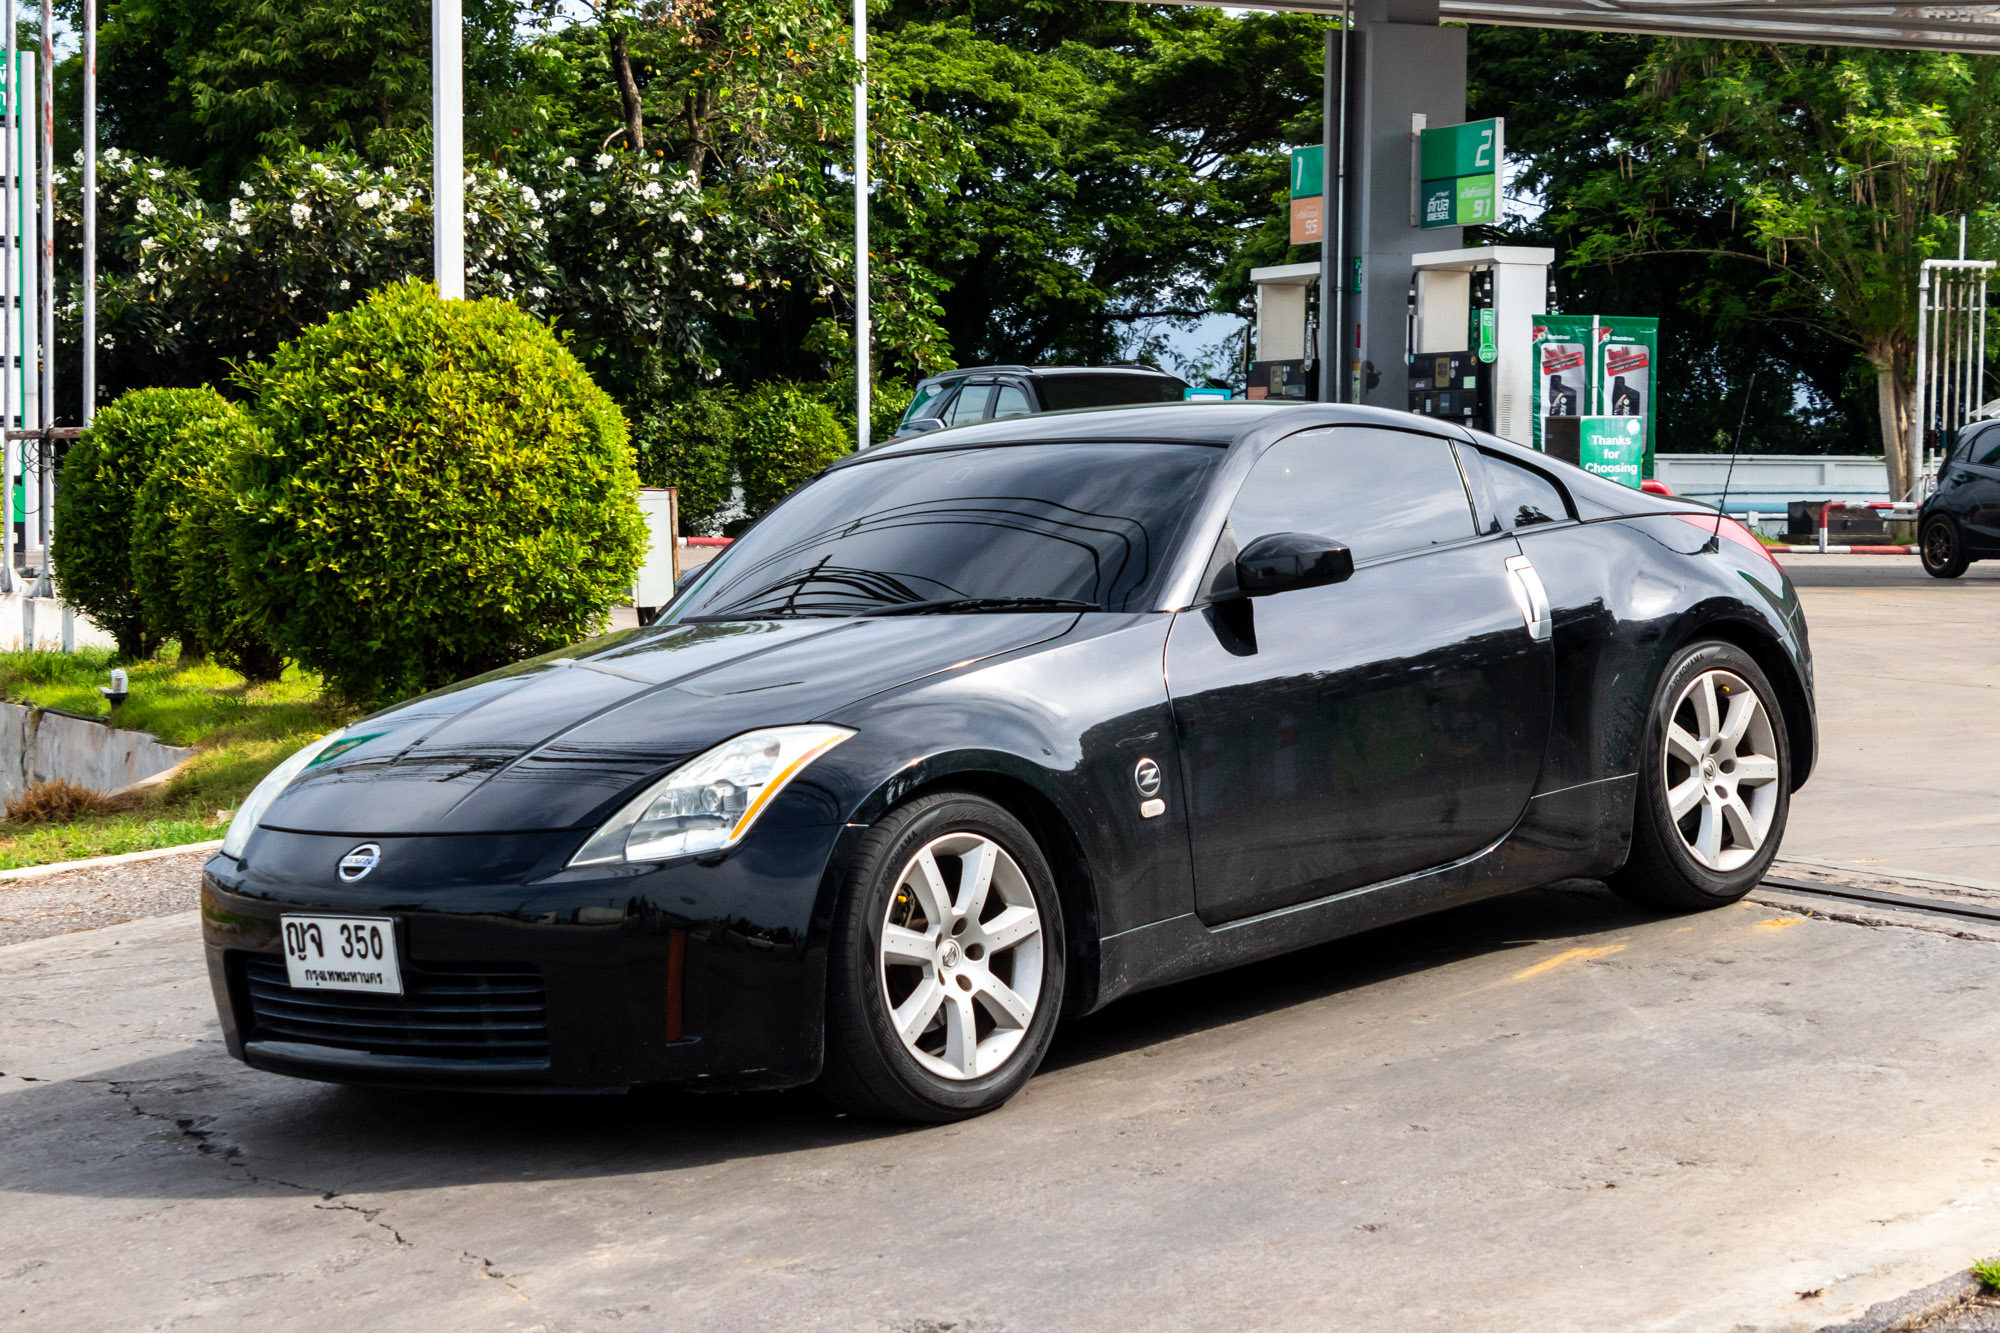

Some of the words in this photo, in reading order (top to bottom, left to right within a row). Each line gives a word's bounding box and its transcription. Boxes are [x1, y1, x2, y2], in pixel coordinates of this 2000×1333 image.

[1475, 129, 1493, 167] 2
[1295, 156, 1304, 190] 1
[1427, 211, 1450, 221] DIESEL
[1472, 199, 1491, 218] 91
[1305, 219, 1318, 235] 95
[1591, 435, 1632, 446] Thanks
[1603, 449, 1620, 459] for
[1585, 462, 1638, 475] Choosing
[1672, 653, 1704, 685] YOKOHAMA
[1140, 768, 1159, 785] Z
[881, 829, 918, 886] YOKOHAMA
[286, 922, 324, 960] ญจ
[340, 924, 383, 960] 350
[305, 969, 383, 986] กรุงเทพมหานคร
